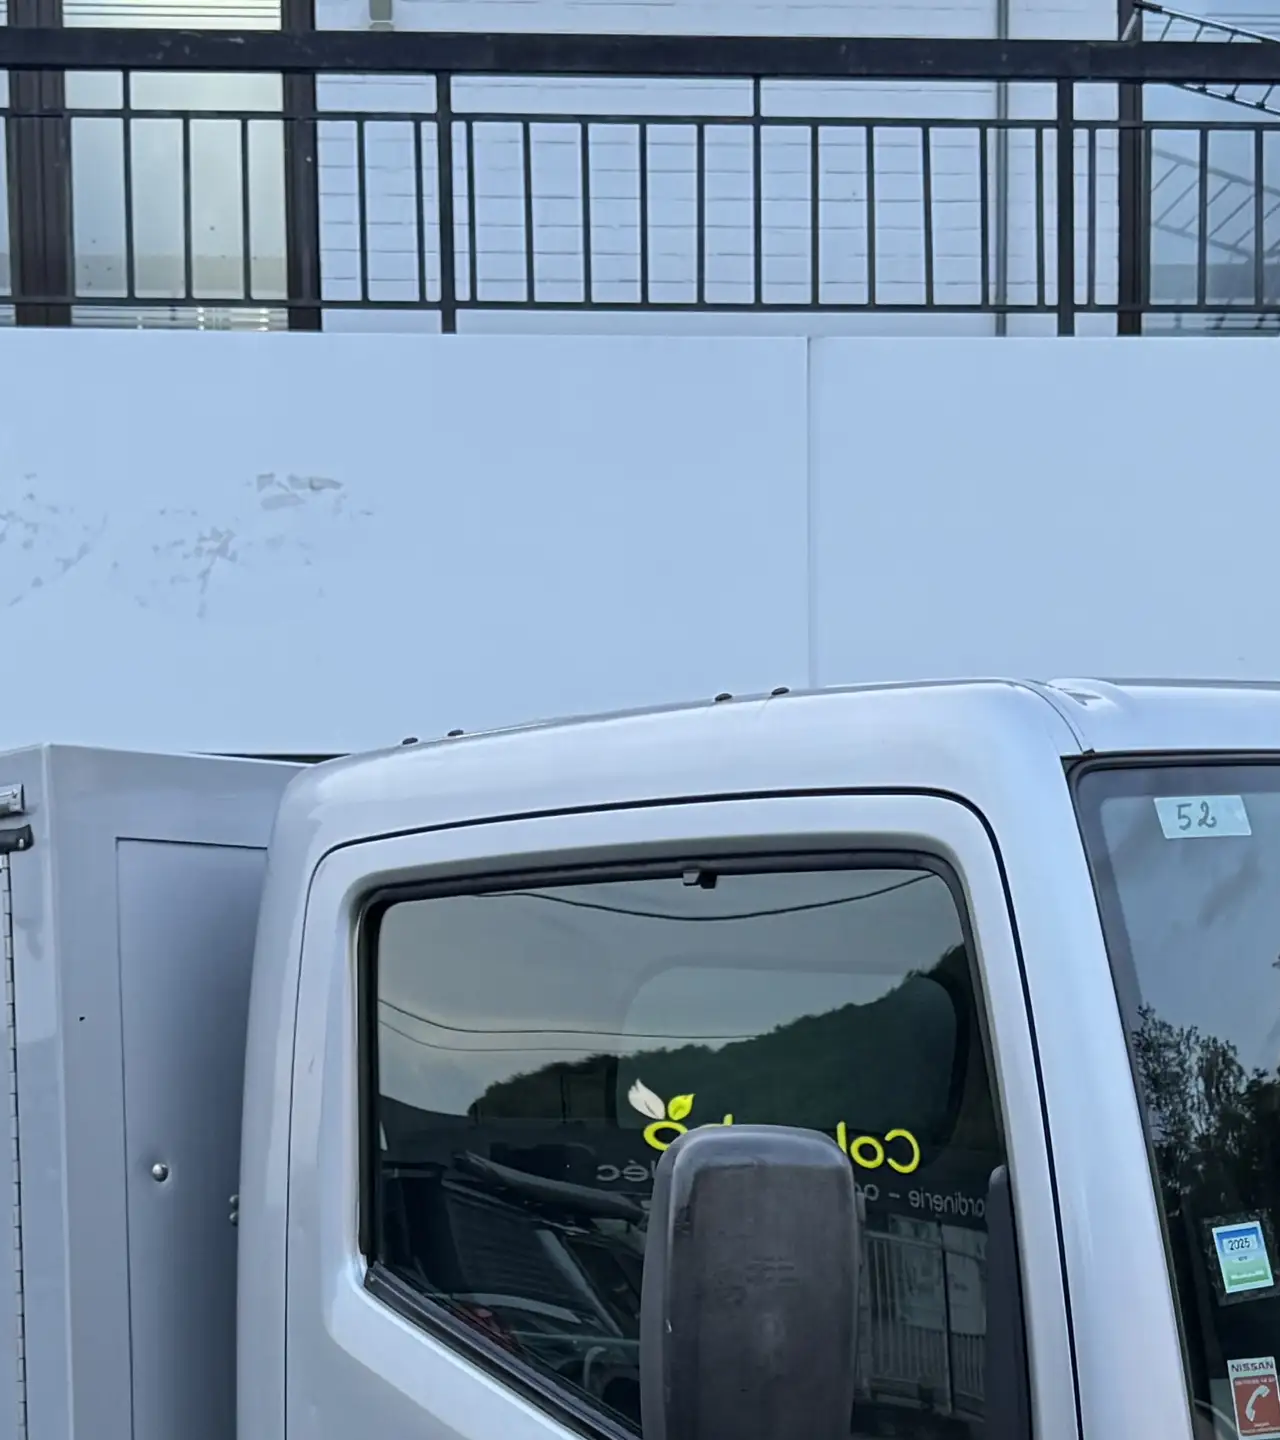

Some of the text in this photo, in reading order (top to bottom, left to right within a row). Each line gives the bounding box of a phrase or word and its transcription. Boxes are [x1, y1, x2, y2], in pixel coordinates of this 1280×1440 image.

[1176, 800, 1217, 831] 52
[1227, 1237, 1251, 1251] 2025
[1231, 1360, 1274, 1373] NISSAN
